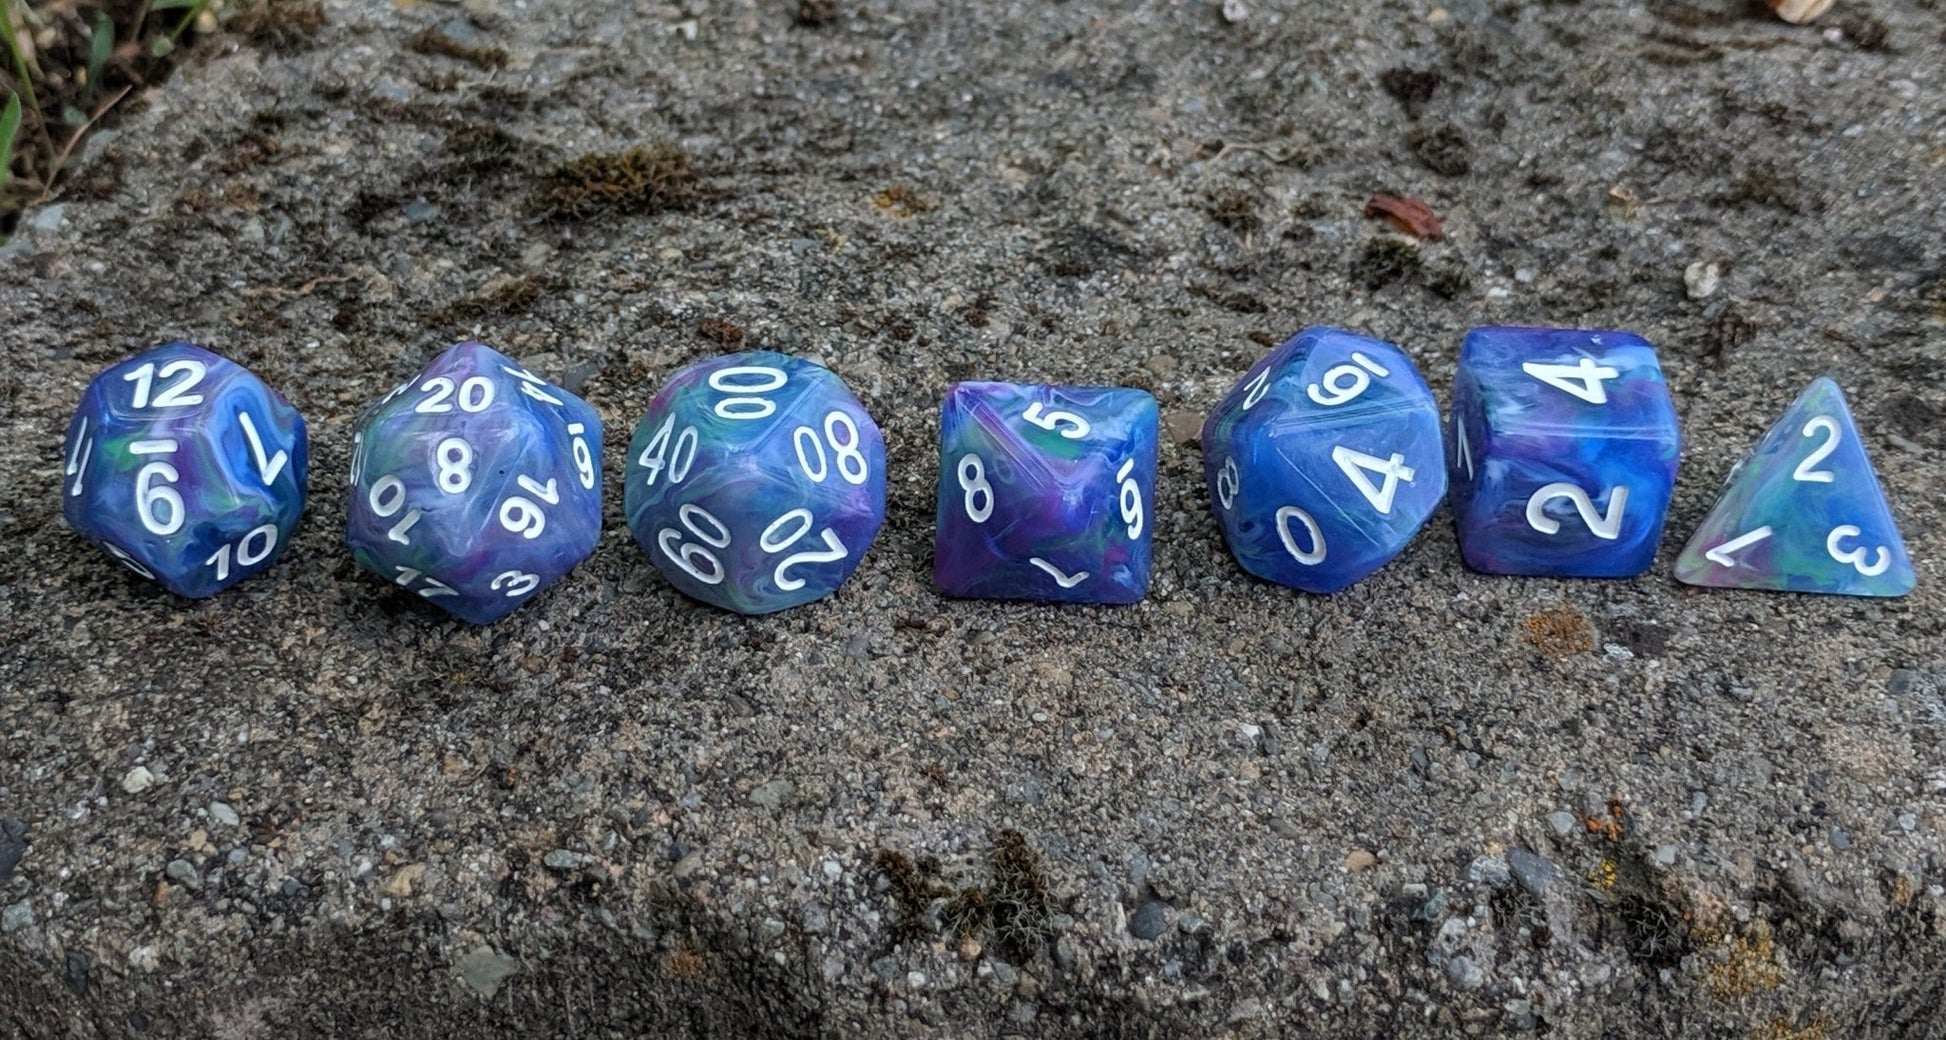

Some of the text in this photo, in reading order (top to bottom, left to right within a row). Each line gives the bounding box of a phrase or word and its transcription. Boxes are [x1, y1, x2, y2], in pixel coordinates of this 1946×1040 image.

[123, 360, 207, 408] 12
[415, 376, 495, 413] 20
[708, 366, 788, 420] 00
[1522, 358, 1619, 404] 4
[638, 411, 698, 485] 40
[793, 410, 868, 485] 80
[1022, 401, 1091, 438] 5
[436, 437, 474, 494] 8
[1793, 415, 1842, 483] 2
[499, 474, 560, 539] 16
[958, 453, 994, 523] 8
[1217, 456, 1239, 510] 8
[1332, 445, 1416, 514] 4
[369, 474, 422, 545] 10
[1276, 505, 1327, 565] 0
[1526, 482, 1629, 539] 2
[205, 524, 278, 581] 10
[658, 503, 732, 584] 60
[760, 508, 848, 591] 20
[1705, 525, 1772, 567] 1
[1827, 524, 1891, 576] 3
[490, 570, 540, 597] 3
